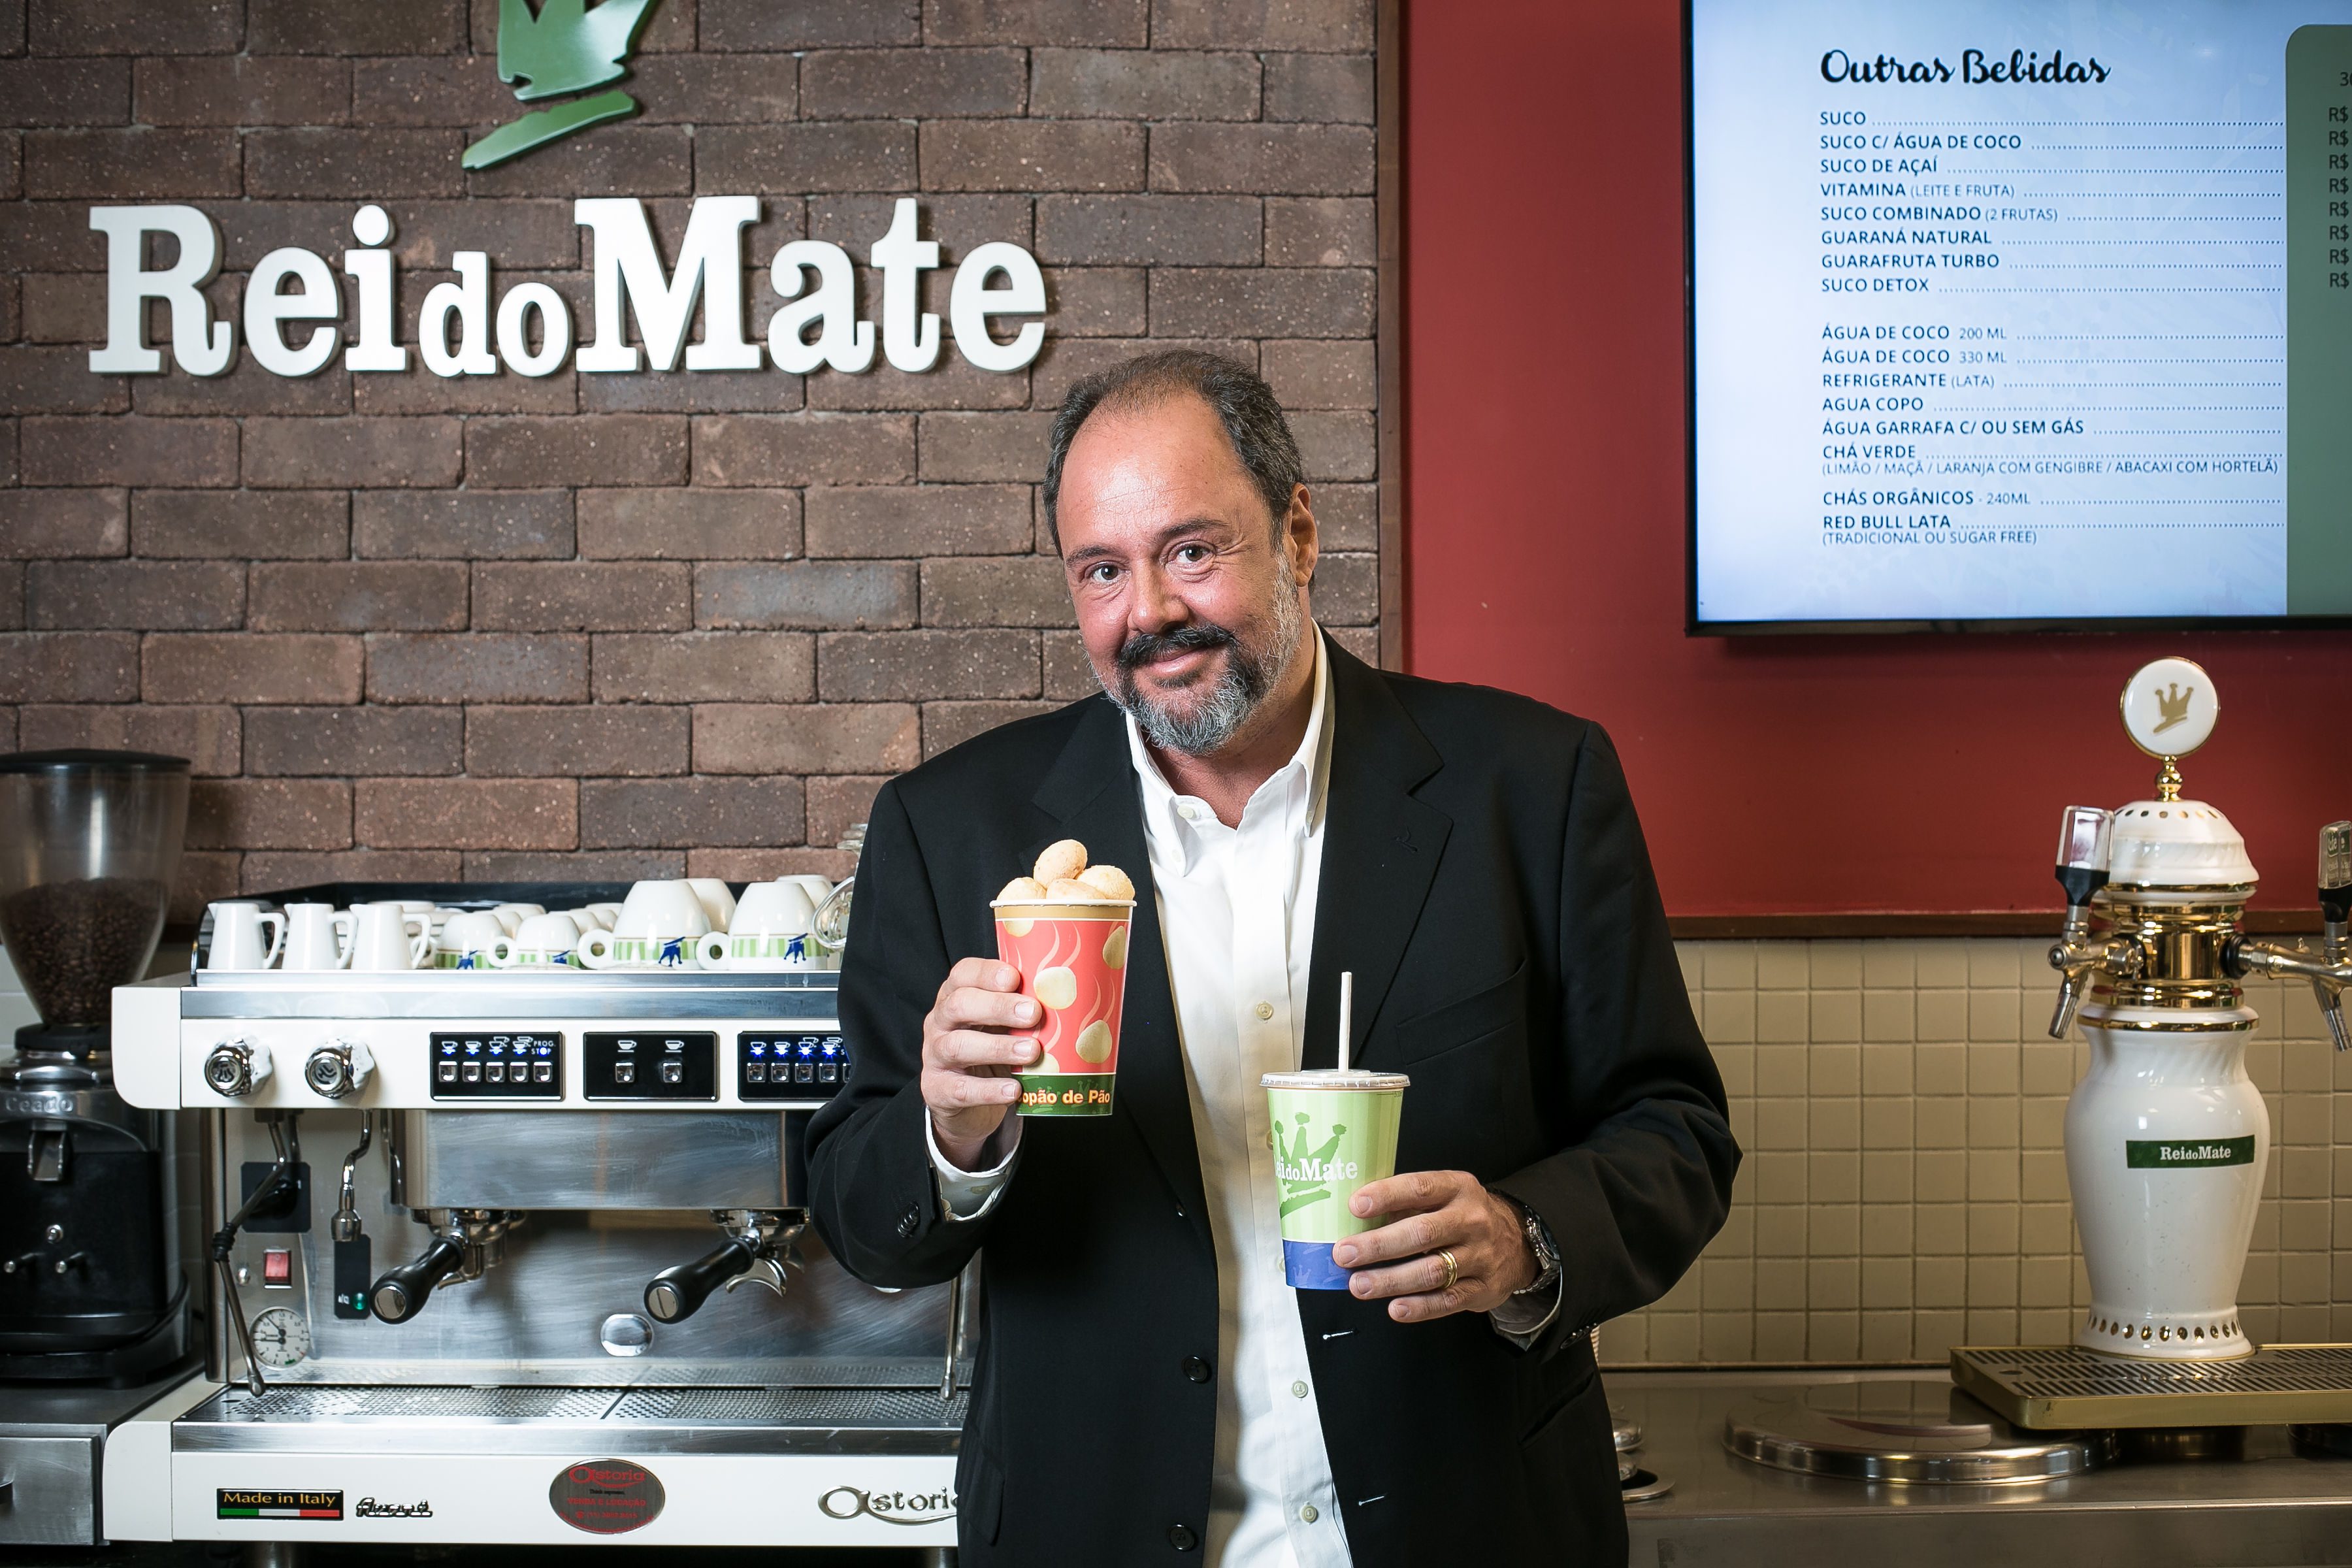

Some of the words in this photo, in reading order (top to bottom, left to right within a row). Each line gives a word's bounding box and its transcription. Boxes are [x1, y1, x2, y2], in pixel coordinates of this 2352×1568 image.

[1820, 48, 1955, 84] Outras
[1962, 48, 2112, 84] Bebidas
[1820, 111, 1867, 125] SUCO
[1820, 135, 1867, 150] SUCO
[1872, 135, 1889, 150] C/
[1893, 131, 1942, 150] ÁGUA
[1948, 135, 1968, 149] DE
[1973, 134, 2021, 150] COCO
[1820, 158, 1867, 173] SUCO
[1872, 159, 1893, 172] DE
[1897, 154, 1938, 176] AÇAÍ
[1820, 182, 1906, 197] VITAMINA
[1910, 184, 1950, 199] (LEITE
[1954, 184, 1961, 197] E
[1966, 184, 2015, 199] FRUTA)
[1821, 206, 1867, 221] SUCO
[1872, 206, 1982, 221] COMBINADO
[1985, 208, 1997, 223] (2
[2001, 208, 2058, 223] FRUTAS)
[1821, 226, 1907, 245] GUARANÁ
[1912, 229, 1992, 245] NATURAL
[1821, 253, 1936, 269] GUARAFRUTA
[1940, 253, 2000, 269] TURBO
[1821, 278, 1868, 293] SUCO
[1873, 278, 1929, 292] DETOX
[1821, 322, 1870, 340] ÁGUA
[1876, 325, 1897, 340] DE
[1902, 325, 1950, 340] COCO
[1959, 327, 1983, 340] 200
[1987, 327, 2006, 339] ML
[1821, 346, 1870, 364] ÁGUA
[1876, 350, 1897, 364] DE
[1902, 349, 1950, 364] COCO
[1959, 351, 1984, 364] 330
[1987, 351, 2006, 363] ML
[1823, 373, 1946, 387] REFRIGERANTE
[1951, 374, 1995, 389] (LATA)
[1876, 397, 1923, 412] COPO
[1822, 417, 1871, 436] ÁGUA
[1876, 420, 1955, 435] GARRAFA
[1959, 420, 1977, 435] C/
[1982, 420, 2007, 435] OU
[2012, 419, 2046, 434] SEM
[2051, 416, 2084, 435] GÁS
[1823, 441, 1858, 459] CHÁ
[1862, 445, 1916, 459] VERDE
[1822, 461, 1871, 476] (LIMÃO
[1884, 459, 1924, 478] MAÇÃ
[1936, 462, 1995, 477] LARANJA
[1999, 461, 2031, 474] COM
[2034, 461, 2103, 474] GENGIBRE
[2115, 461, 2172, 474] ABACAXI
[2176, 460, 2208, 474] COM
[2212, 458, 2278, 475] HORTELÃ)
[1823, 489, 1867, 506] CHÁS
[1872, 487, 1974, 506] ORGÂNICOS
[1987, 492, 2031, 506] 240ML
[1823, 515, 1856, 530] RED
[1861, 515, 1903, 530] BULL
[1908, 514, 1952, 529] LATA
[1822, 532, 1921, 546] (TRADICIONAL
[1925, 531, 1946, 545] OU
[1950, 531, 1996, 545] SUGAR
[2001, 531, 2038, 546] FREE)
[1018, 1087, 1058, 1107] opão
[1062, 1089, 1084, 1104] de
[1088, 1088, 1111, 1104] Pão
[1275, 1156, 1358, 1182] eidoMate
[223, 1492, 272, 1504] Made
[278, 1492, 293, 1504] in
[299, 1493, 336, 1507] Italy
